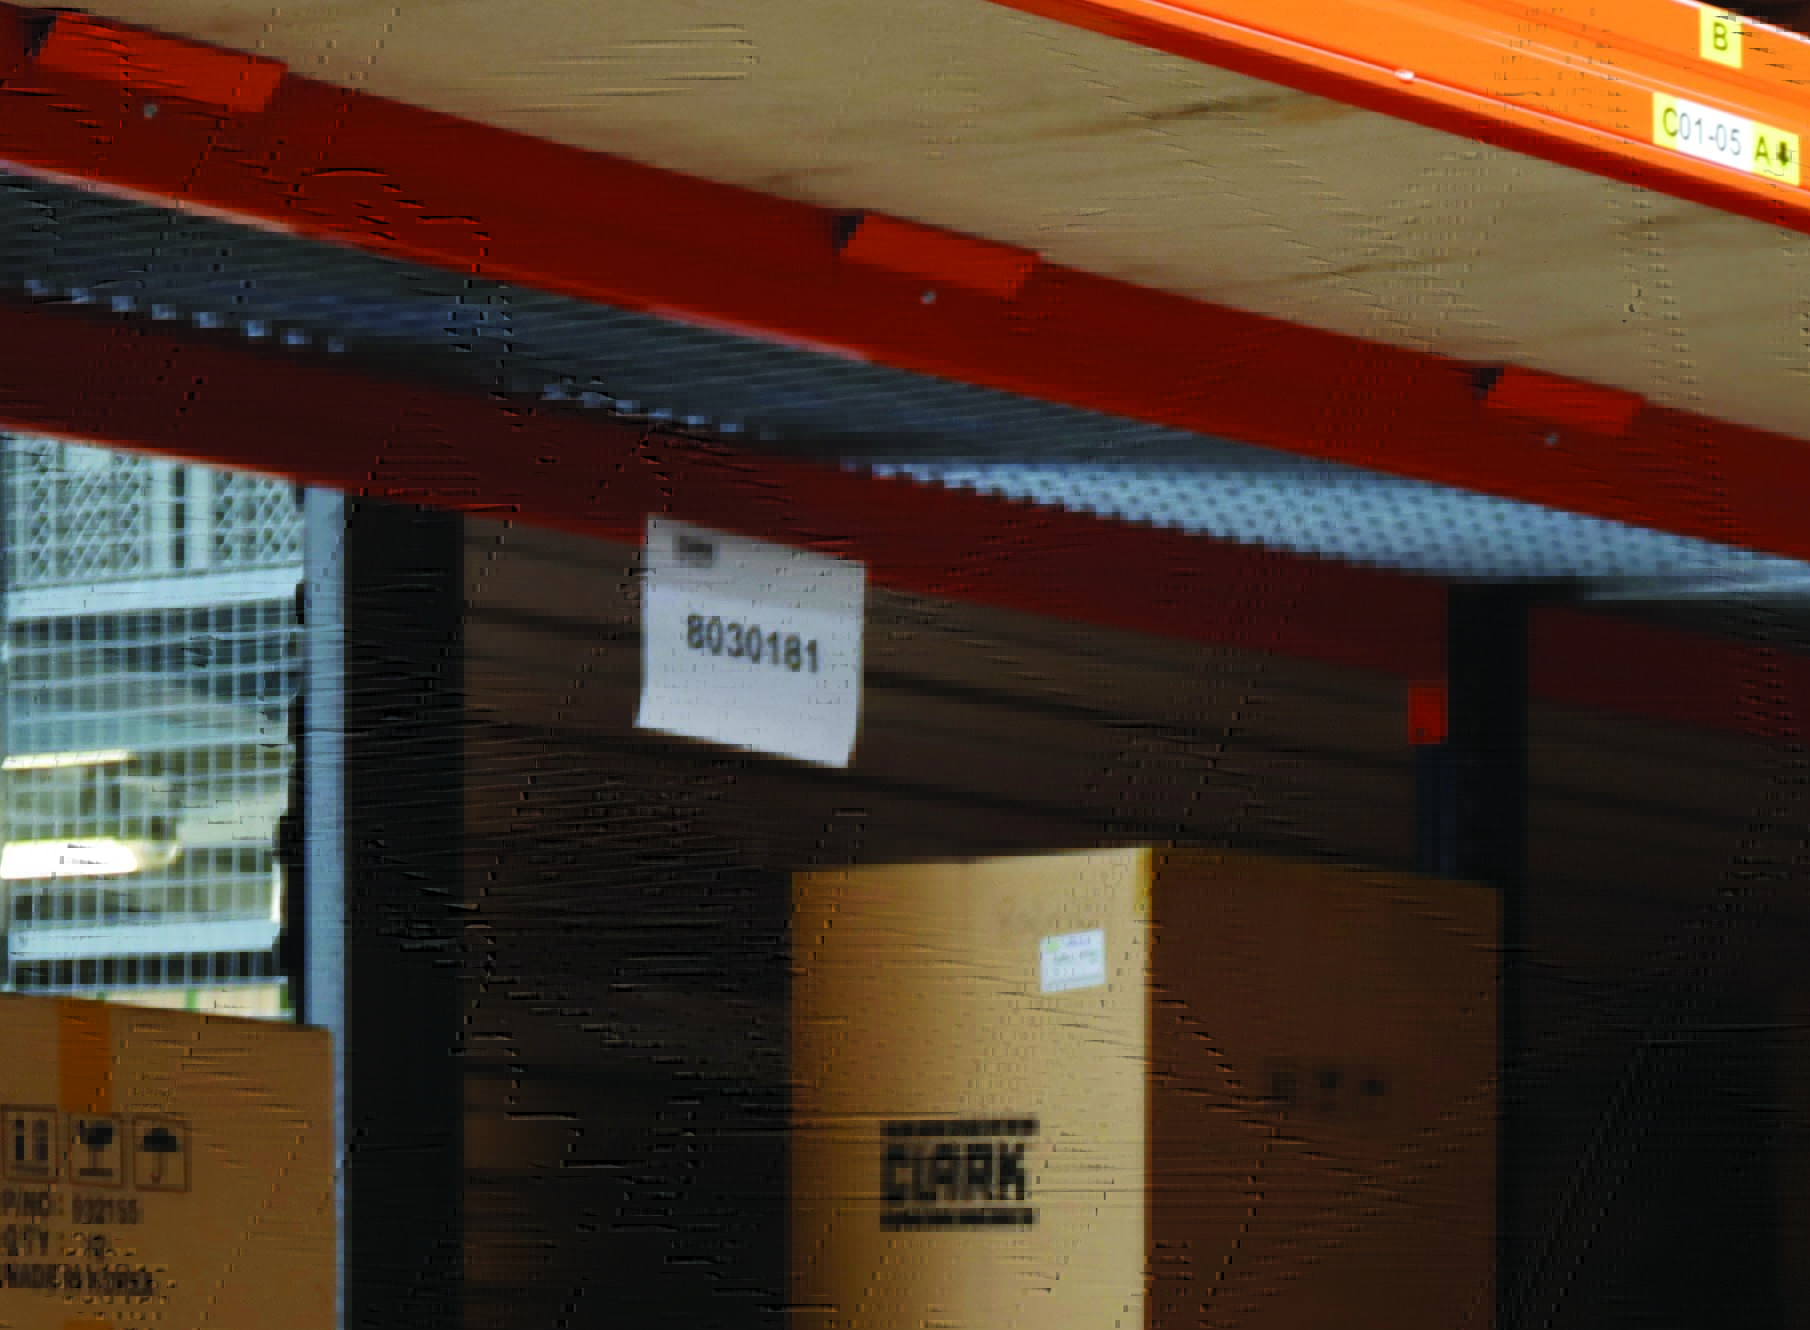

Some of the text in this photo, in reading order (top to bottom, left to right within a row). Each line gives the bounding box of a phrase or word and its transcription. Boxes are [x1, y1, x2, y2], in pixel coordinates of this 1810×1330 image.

[1711, 20, 1730, 54] B
[1661, 106, 1743, 157] C01-05
[687, 613, 818, 673] 8030181
[883, 1142, 1026, 1202] CLARK
